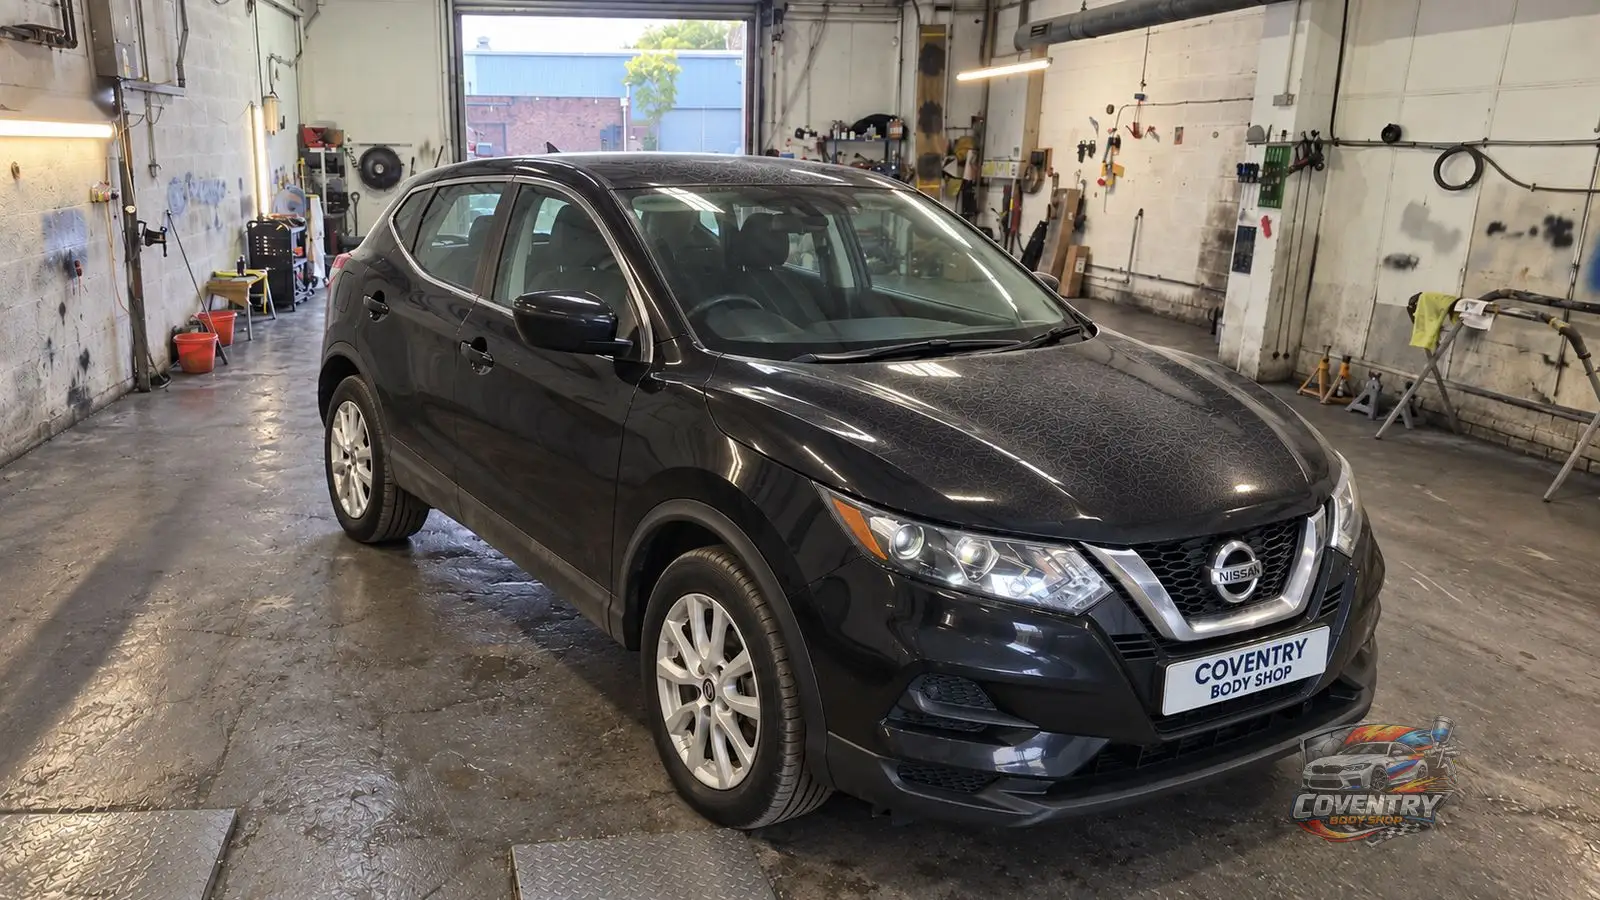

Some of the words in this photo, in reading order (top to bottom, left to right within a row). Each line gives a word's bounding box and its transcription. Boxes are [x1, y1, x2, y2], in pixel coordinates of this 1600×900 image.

[1220, 565, 1260, 582] NISSAN
[1195, 638, 1308, 685] COVENTRY
[1210, 676, 1251, 699] BODY
[1254, 665, 1292, 687] SHOP
